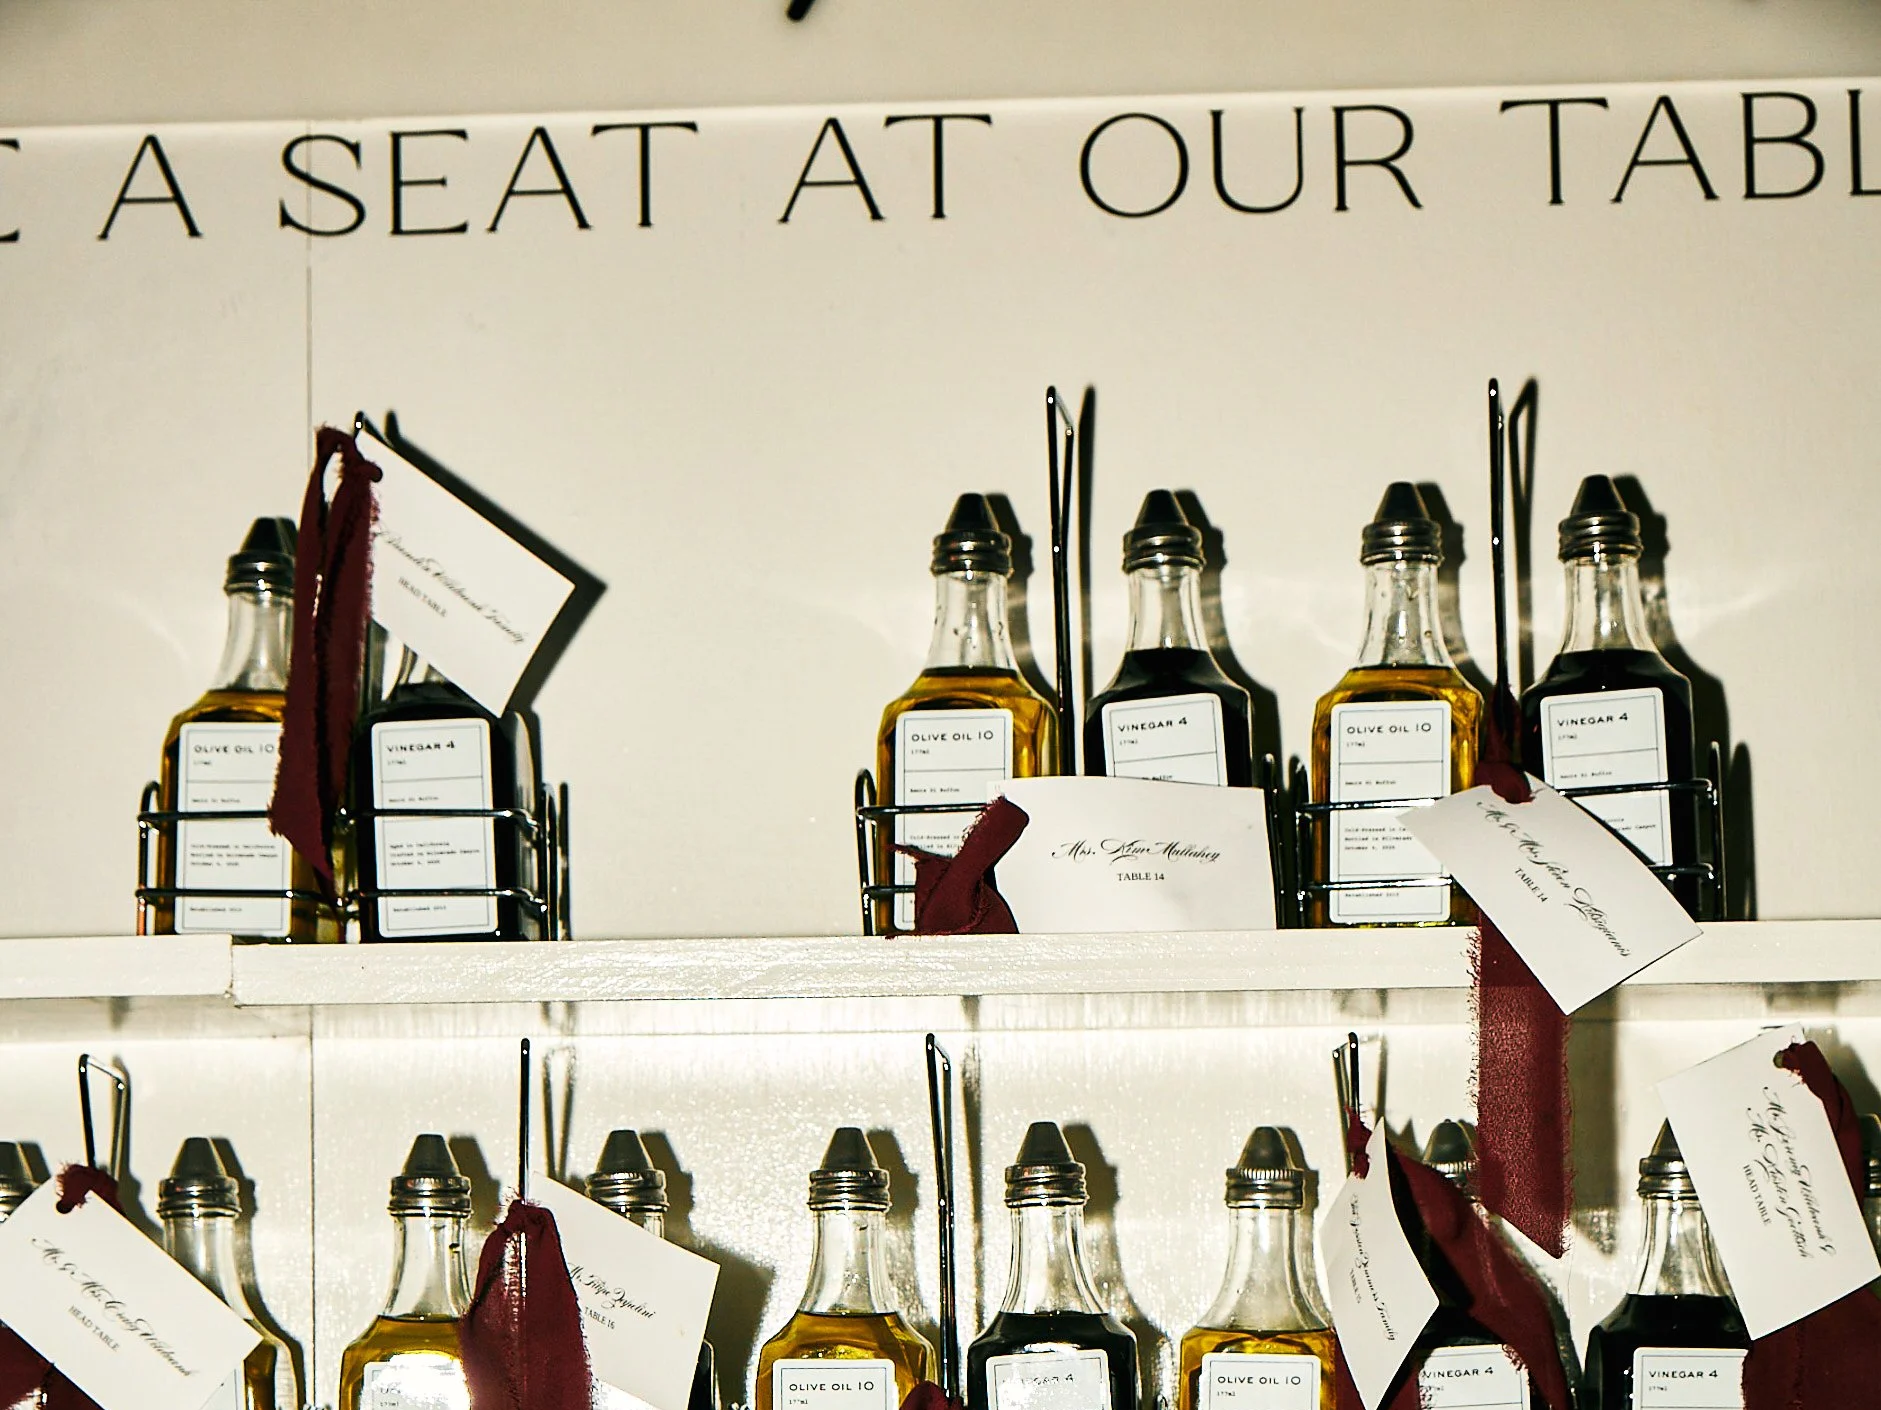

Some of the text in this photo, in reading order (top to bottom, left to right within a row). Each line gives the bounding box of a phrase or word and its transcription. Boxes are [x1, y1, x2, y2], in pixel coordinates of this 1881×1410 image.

[97, 134, 203, 241] A
[279, 121, 698, 238] SEAT
[777, 113, 993, 224] AT
[1079, 104, 1423, 219] OUR
[1118, 717, 1187, 732] VINEGAR 4
[1557, 712, 1628, 727] VINEGAR 4
[1347, 722, 1432, 734] OLIVE OIL 10
[911, 730, 994, 742] OLIVE OIL 10
[194, 745, 228, 754] OLIVE
[234, 745, 253, 754] OIL
[387, 740, 455, 752] VINEGAR 4
[1051, 840, 1096, 861] Mrs.
[1100, 839, 1146, 863] Kim
[1118, 872, 1165, 882] TABLE 14
[1515, 868, 1548, 903] TABLE 14
[1743, 1164, 1772, 1227] HEAD TABLE
[584, 1306, 615, 1330] TABLE 16
[68, 1305, 120, 1351] HEAD TABLE
[1423, 1366, 1493, 1379] VINEGAR 4
[1649, 1370, 1718, 1379] VINEGAR 4
[789, 1381, 874, 1391] OLIVE OIL 10
[1217, 1376, 1301, 1386] OLIVE OIL 10
